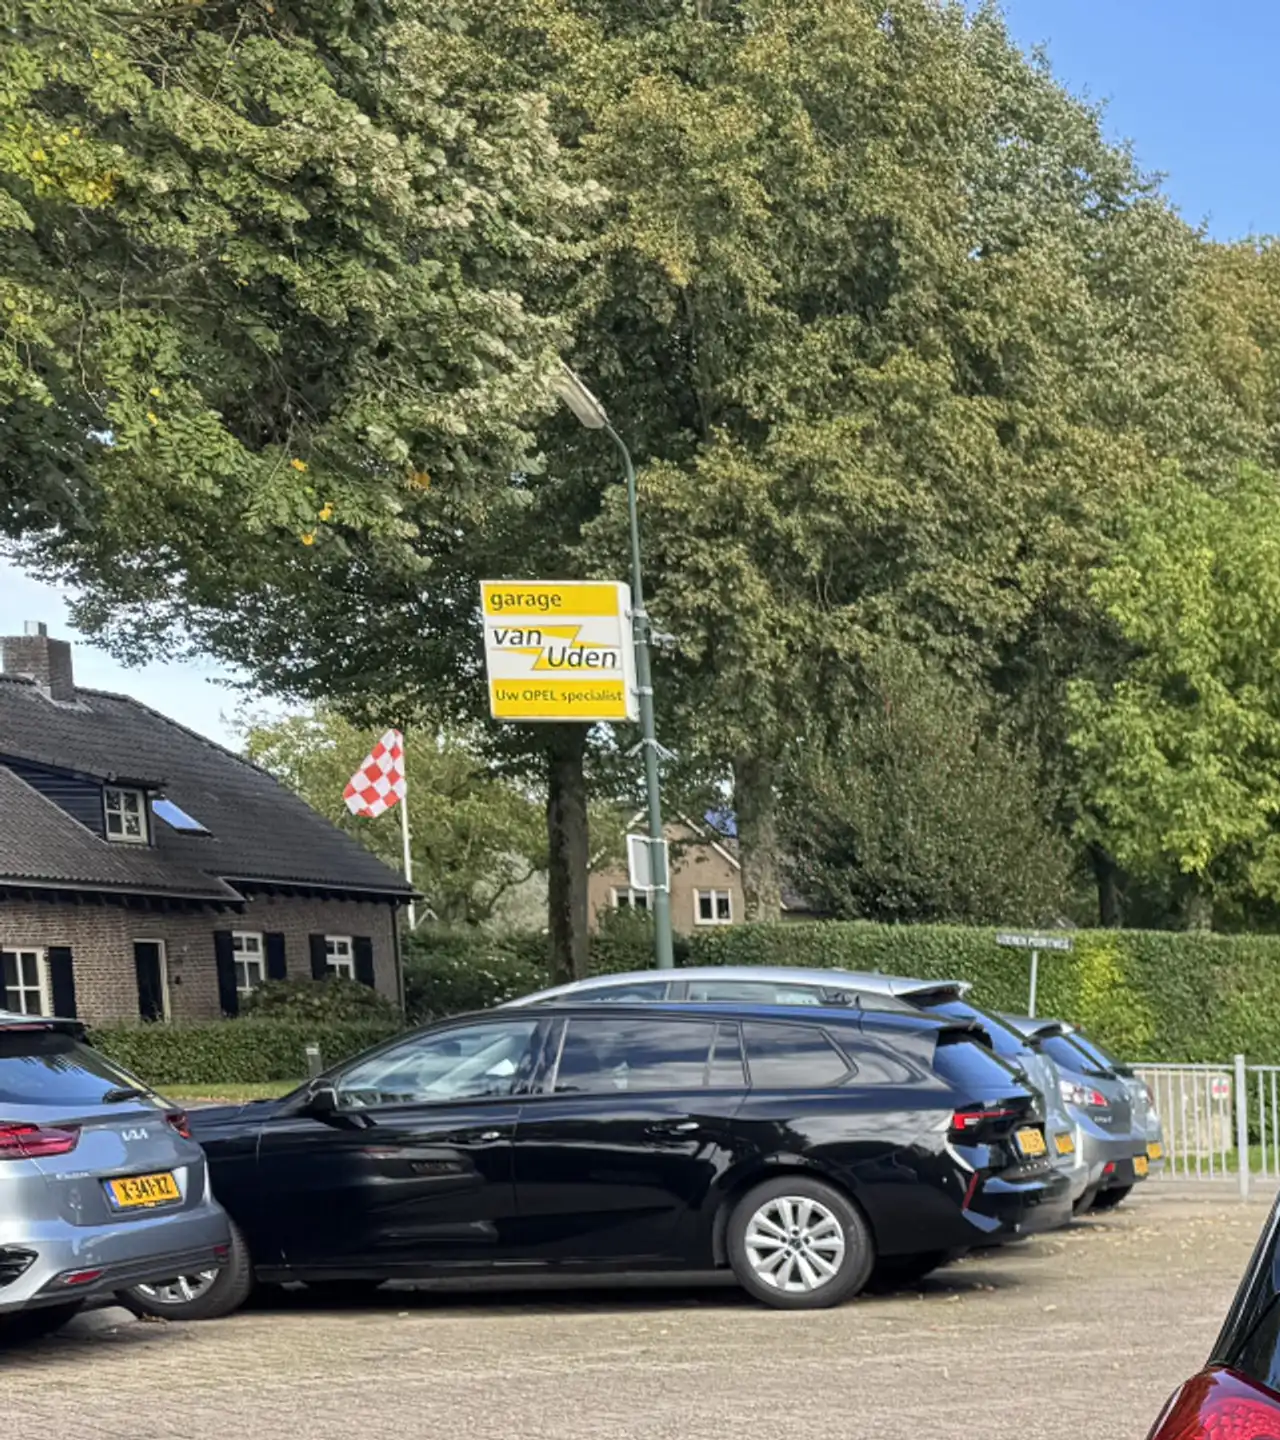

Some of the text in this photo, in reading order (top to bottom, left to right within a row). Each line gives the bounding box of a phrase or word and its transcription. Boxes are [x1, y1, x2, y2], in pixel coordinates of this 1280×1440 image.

[490, 593, 562, 611] garage
[493, 628, 542, 646] van
[547, 645, 617, 669] Uden
[496, 689, 623, 704] Uw OPEL specialist
